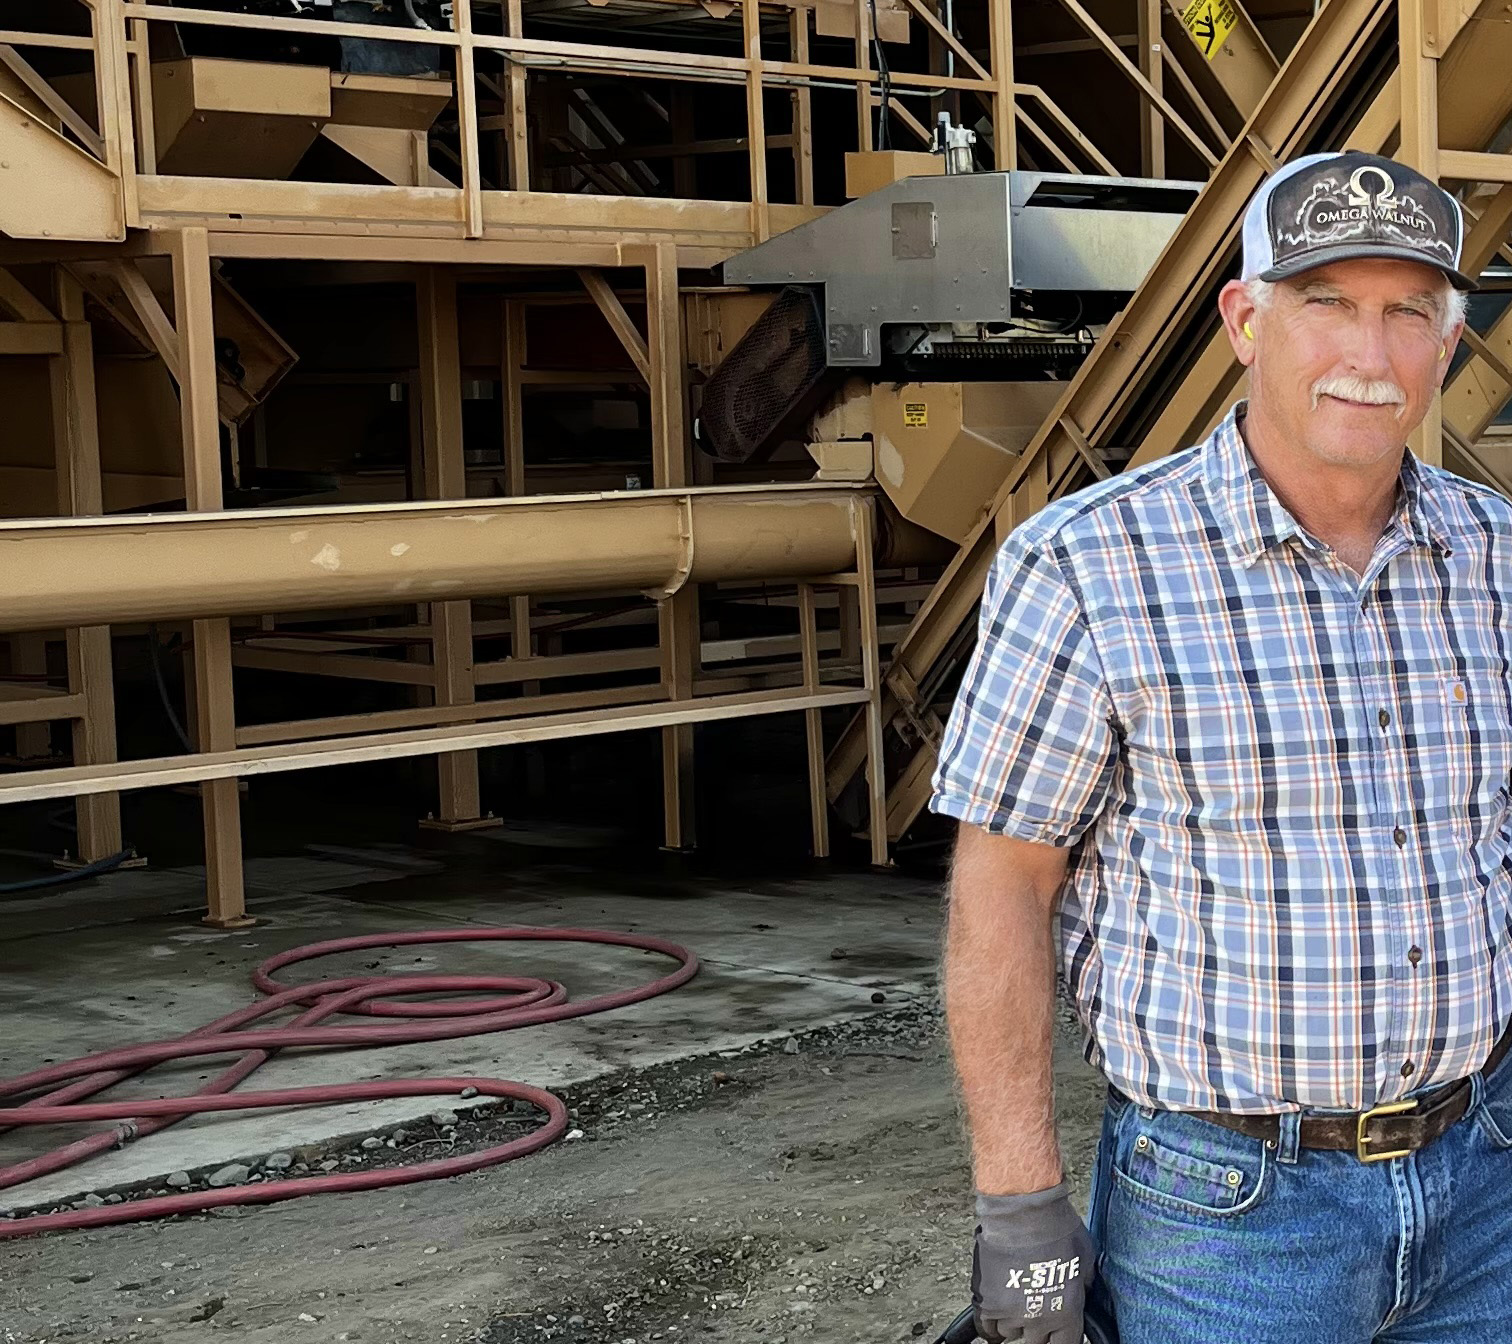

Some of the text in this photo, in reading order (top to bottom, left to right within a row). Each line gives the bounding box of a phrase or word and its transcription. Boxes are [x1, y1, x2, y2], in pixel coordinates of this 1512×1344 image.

[1316, 208, 1427, 232] OMEGA WALNUT
[1005, 1256, 1080, 1288] X-SITE
